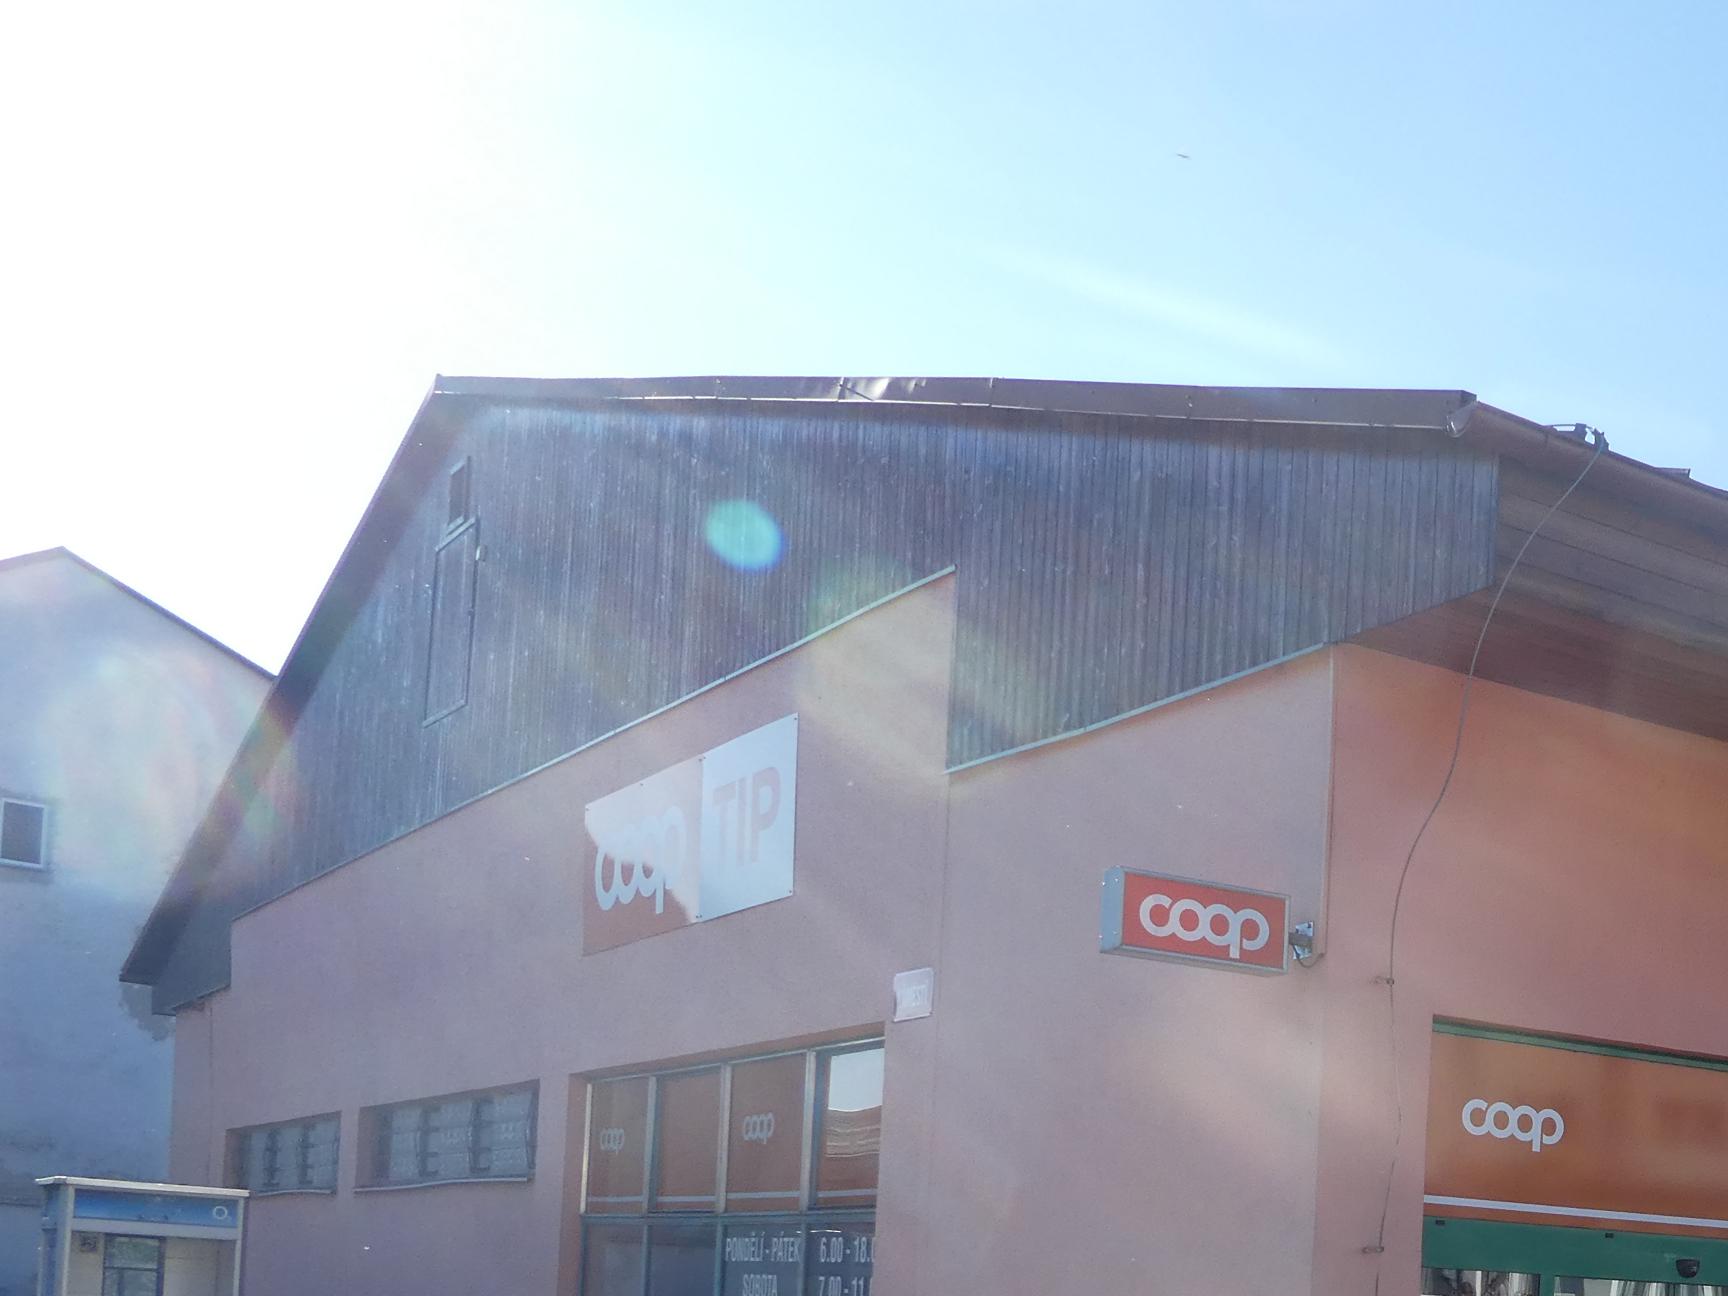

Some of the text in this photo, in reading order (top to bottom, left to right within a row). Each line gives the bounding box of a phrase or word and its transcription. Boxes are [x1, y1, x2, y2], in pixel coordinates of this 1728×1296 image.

[595, 767, 781, 914] coop TIP
[1139, 893, 1270, 959] coop
[600, 1128, 625, 1155] coop
[743, 1112, 775, 1144] coop
[1462, 1098, 1565, 1153] coop
[725, 1231, 765, 1262] PONDĚLÍ
[770, 1231, 800, 1262] PÁTEK
[820, 1237, 844, 1263] 6.00
[853, 1236, 875, 1263] 18.
